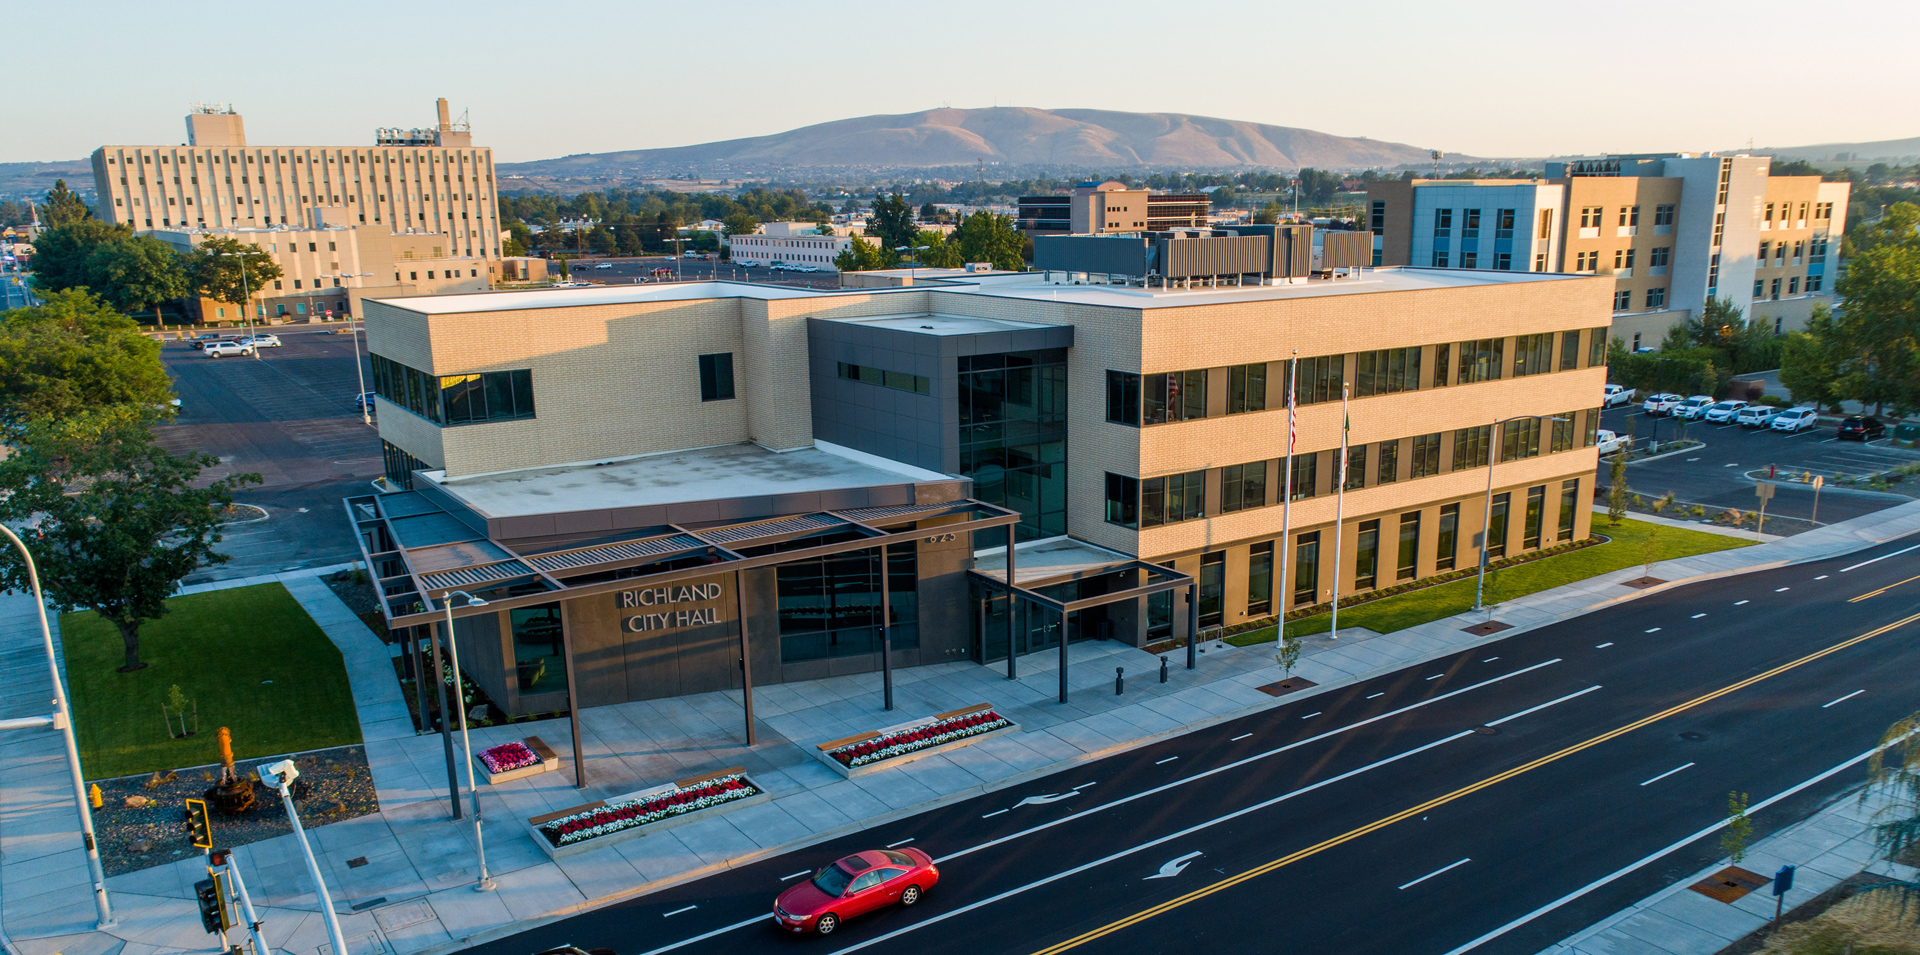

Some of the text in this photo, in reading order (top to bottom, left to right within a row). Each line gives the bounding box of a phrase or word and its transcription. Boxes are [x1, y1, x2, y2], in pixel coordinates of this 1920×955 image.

[623, 583, 722, 608] RICHLAND
[628, 607, 721, 632] CITY HALL
